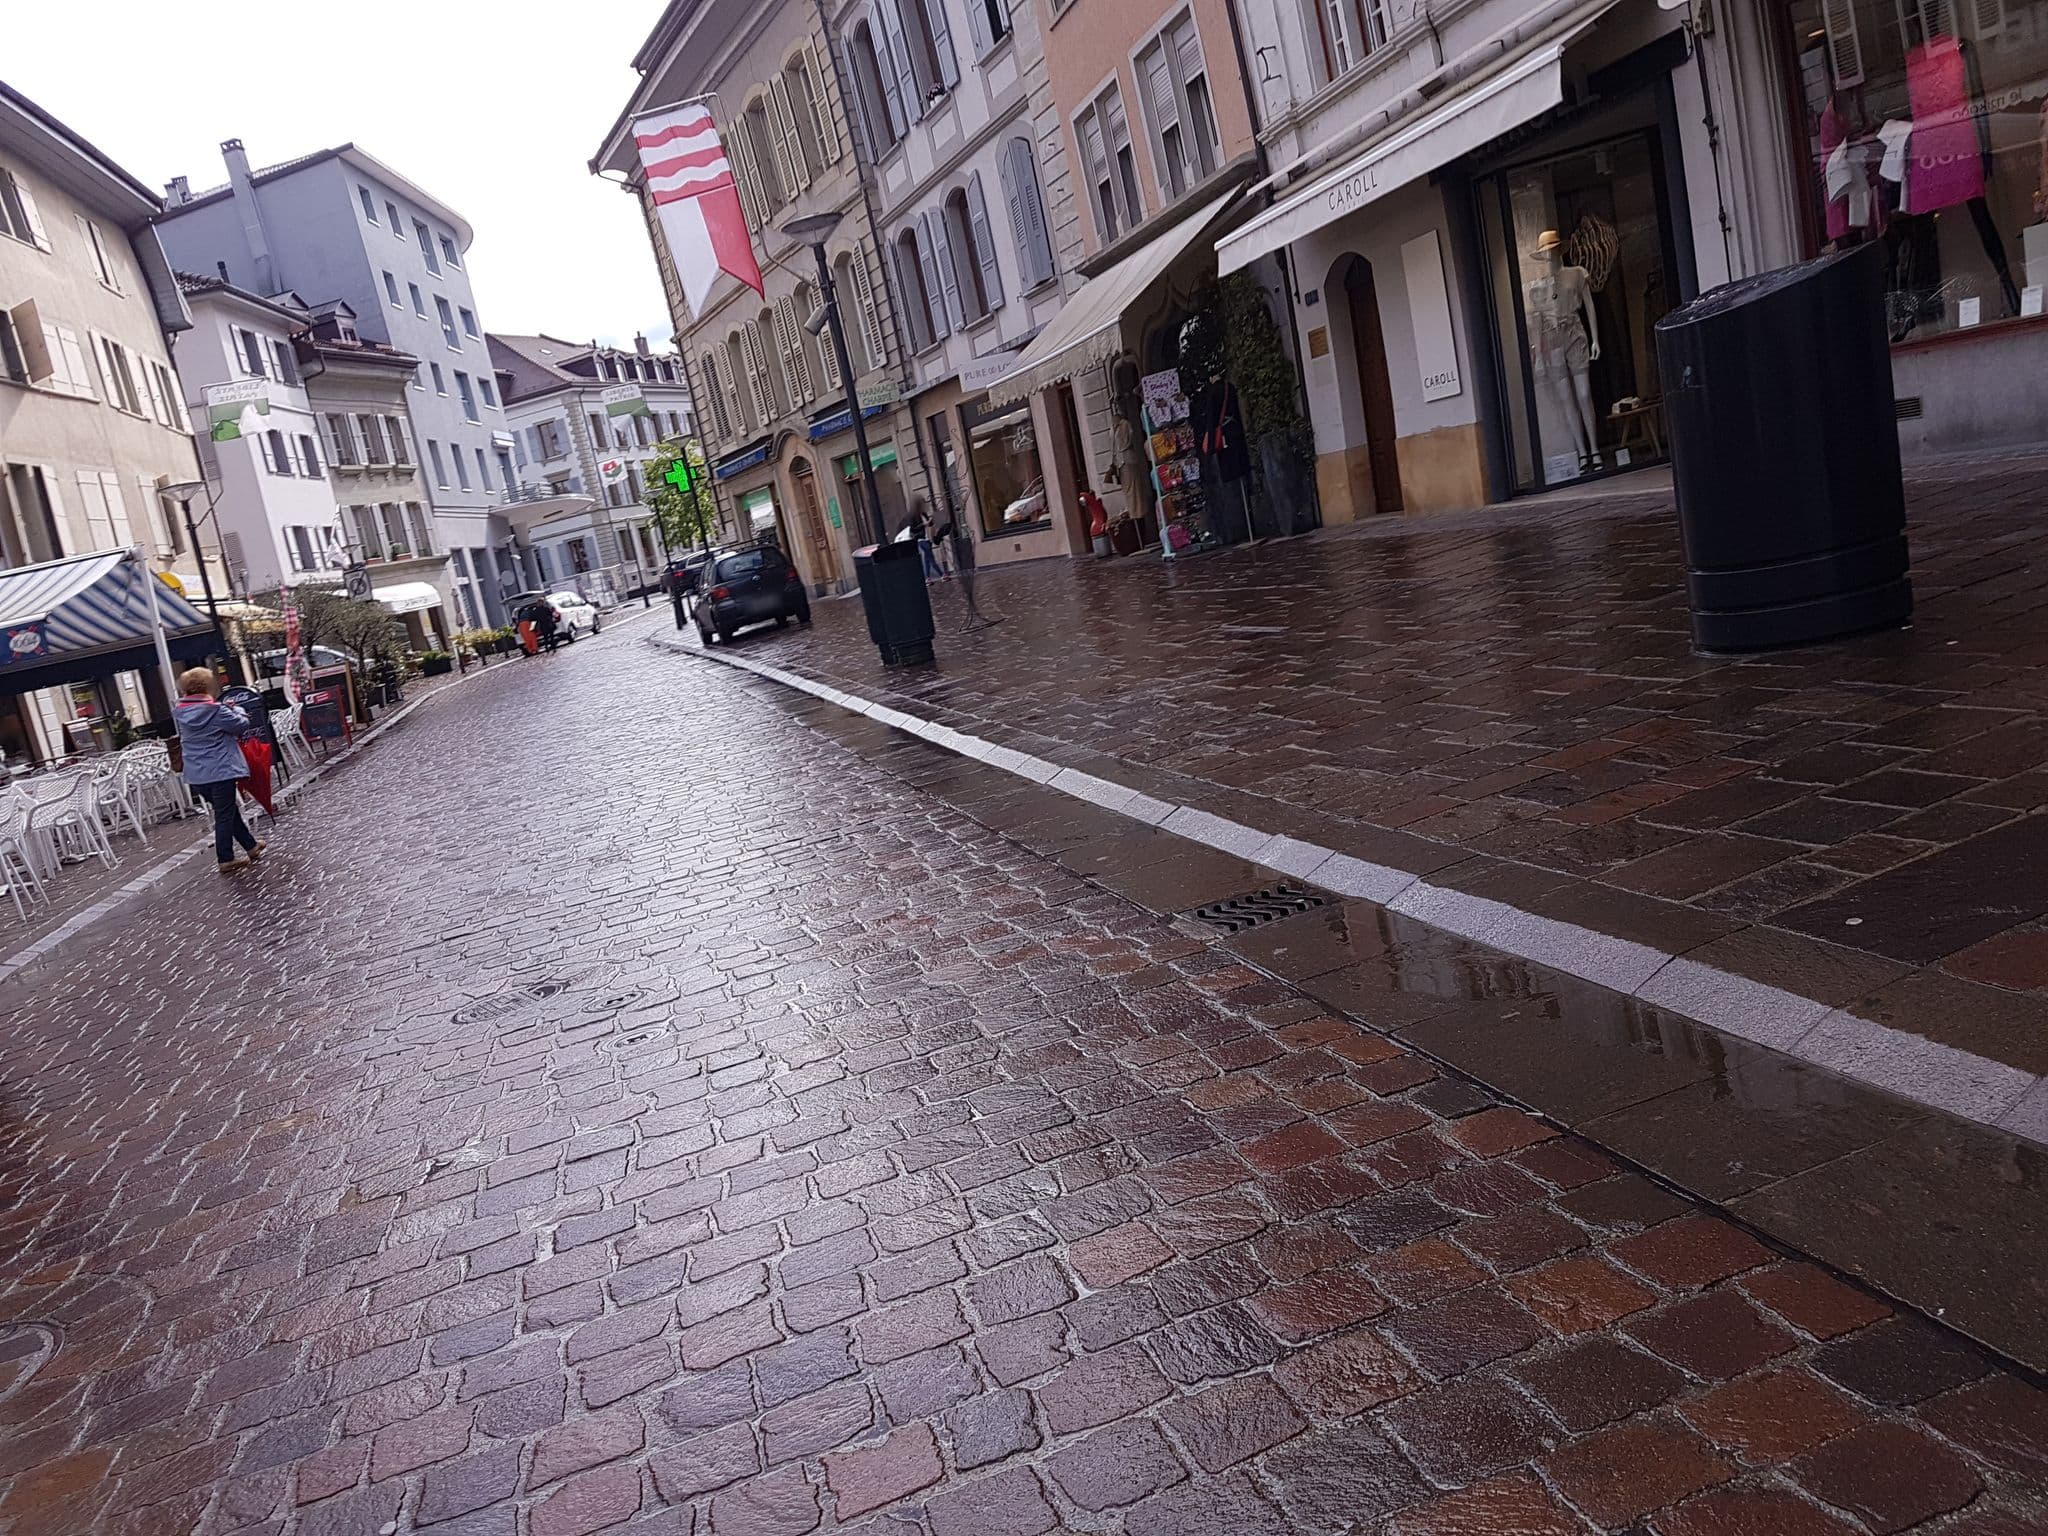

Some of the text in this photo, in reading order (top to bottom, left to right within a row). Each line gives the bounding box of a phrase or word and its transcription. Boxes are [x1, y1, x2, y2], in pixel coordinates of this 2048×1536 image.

[1328, 170, 1378, 210] CAROLL
[963, 367, 986, 381] PURE
[1424, 370, 1457, 389] CAROLL
